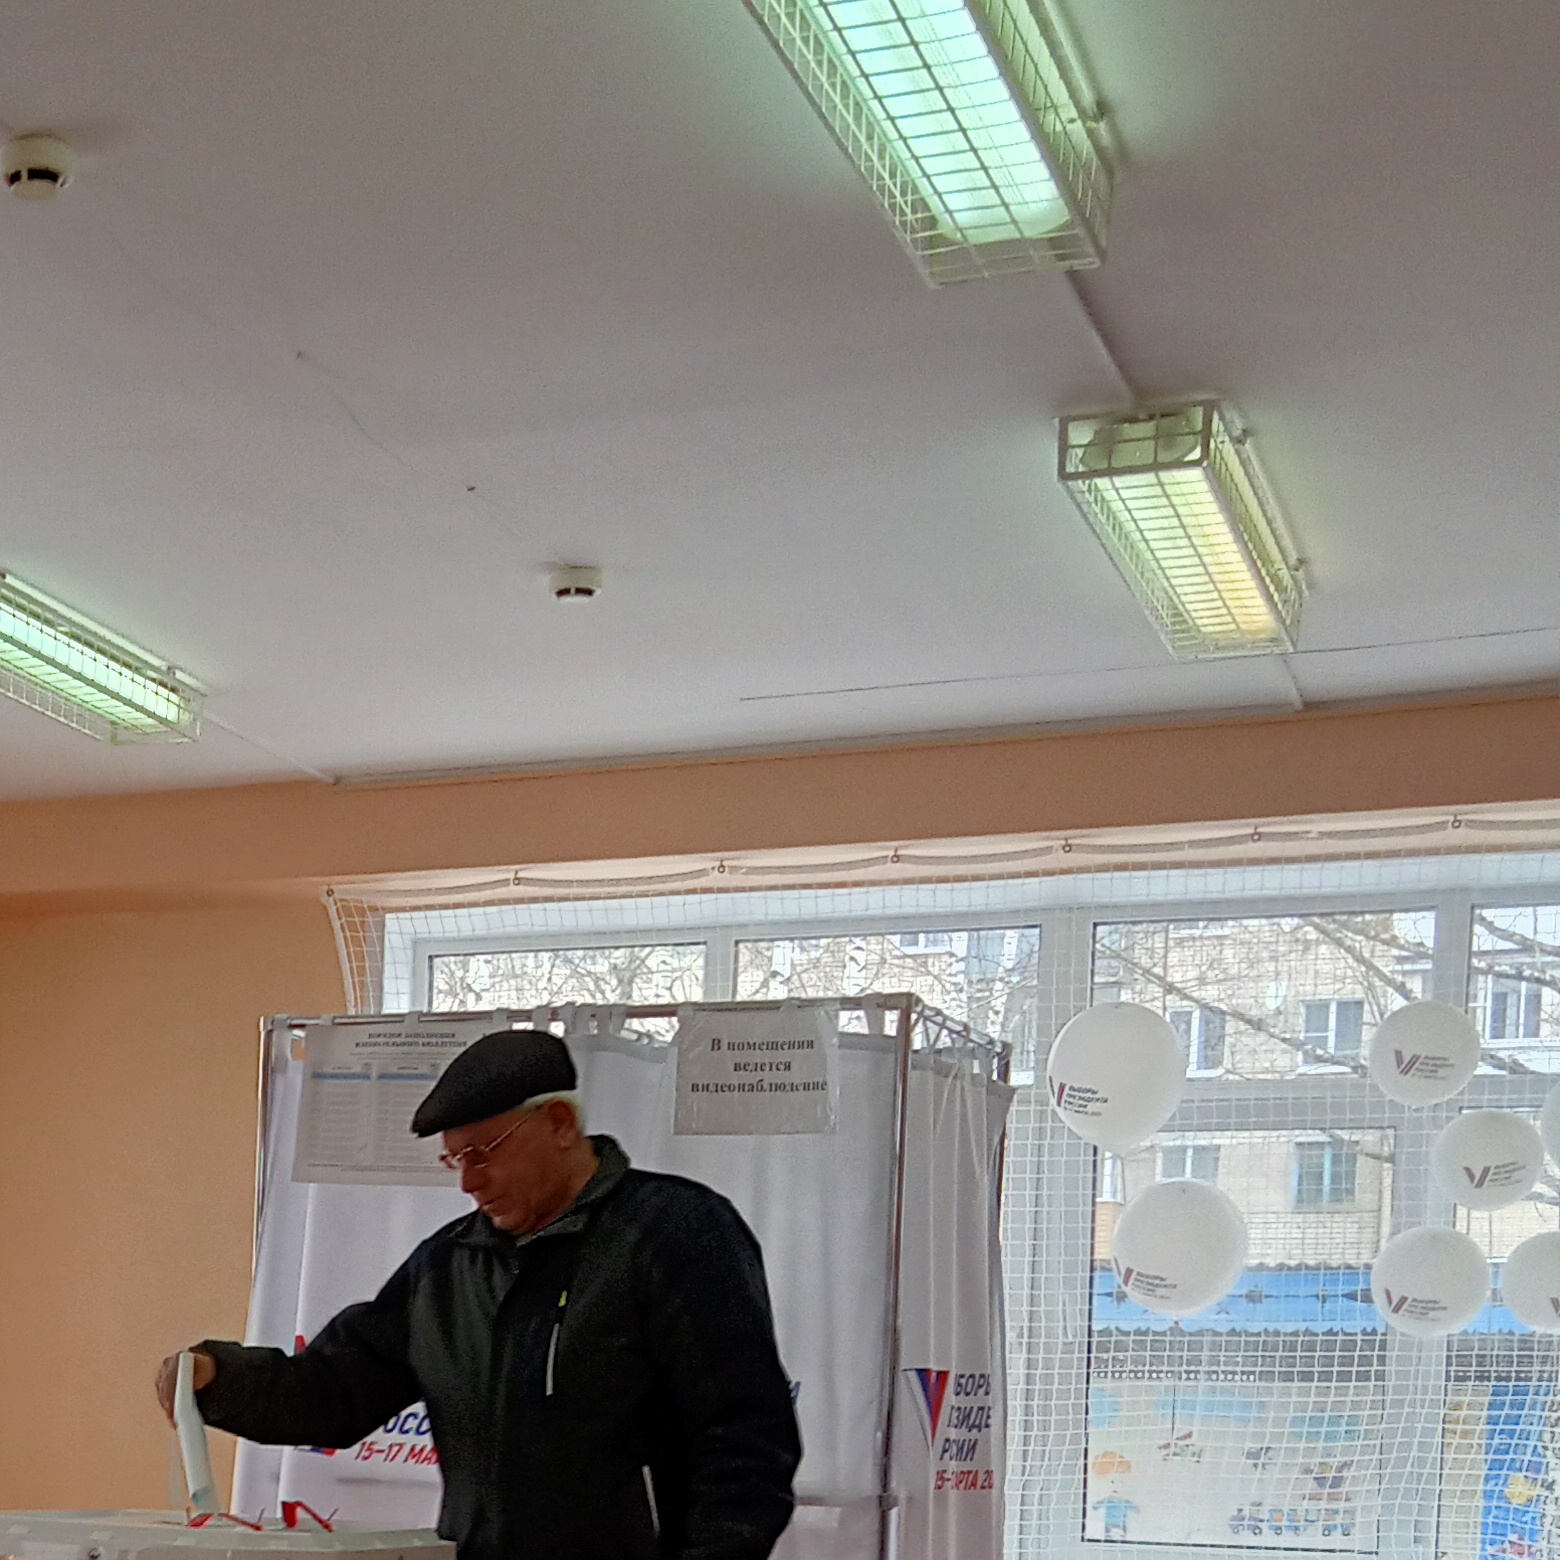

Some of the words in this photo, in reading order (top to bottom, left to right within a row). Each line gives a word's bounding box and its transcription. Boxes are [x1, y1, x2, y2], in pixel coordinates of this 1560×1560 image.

[711, 1038, 722, 1052] В
[727, 1038, 815, 1052] помещении
[733, 1060, 792, 1074] ведется
[691, 1078, 829, 1094] видеонаблюдение
